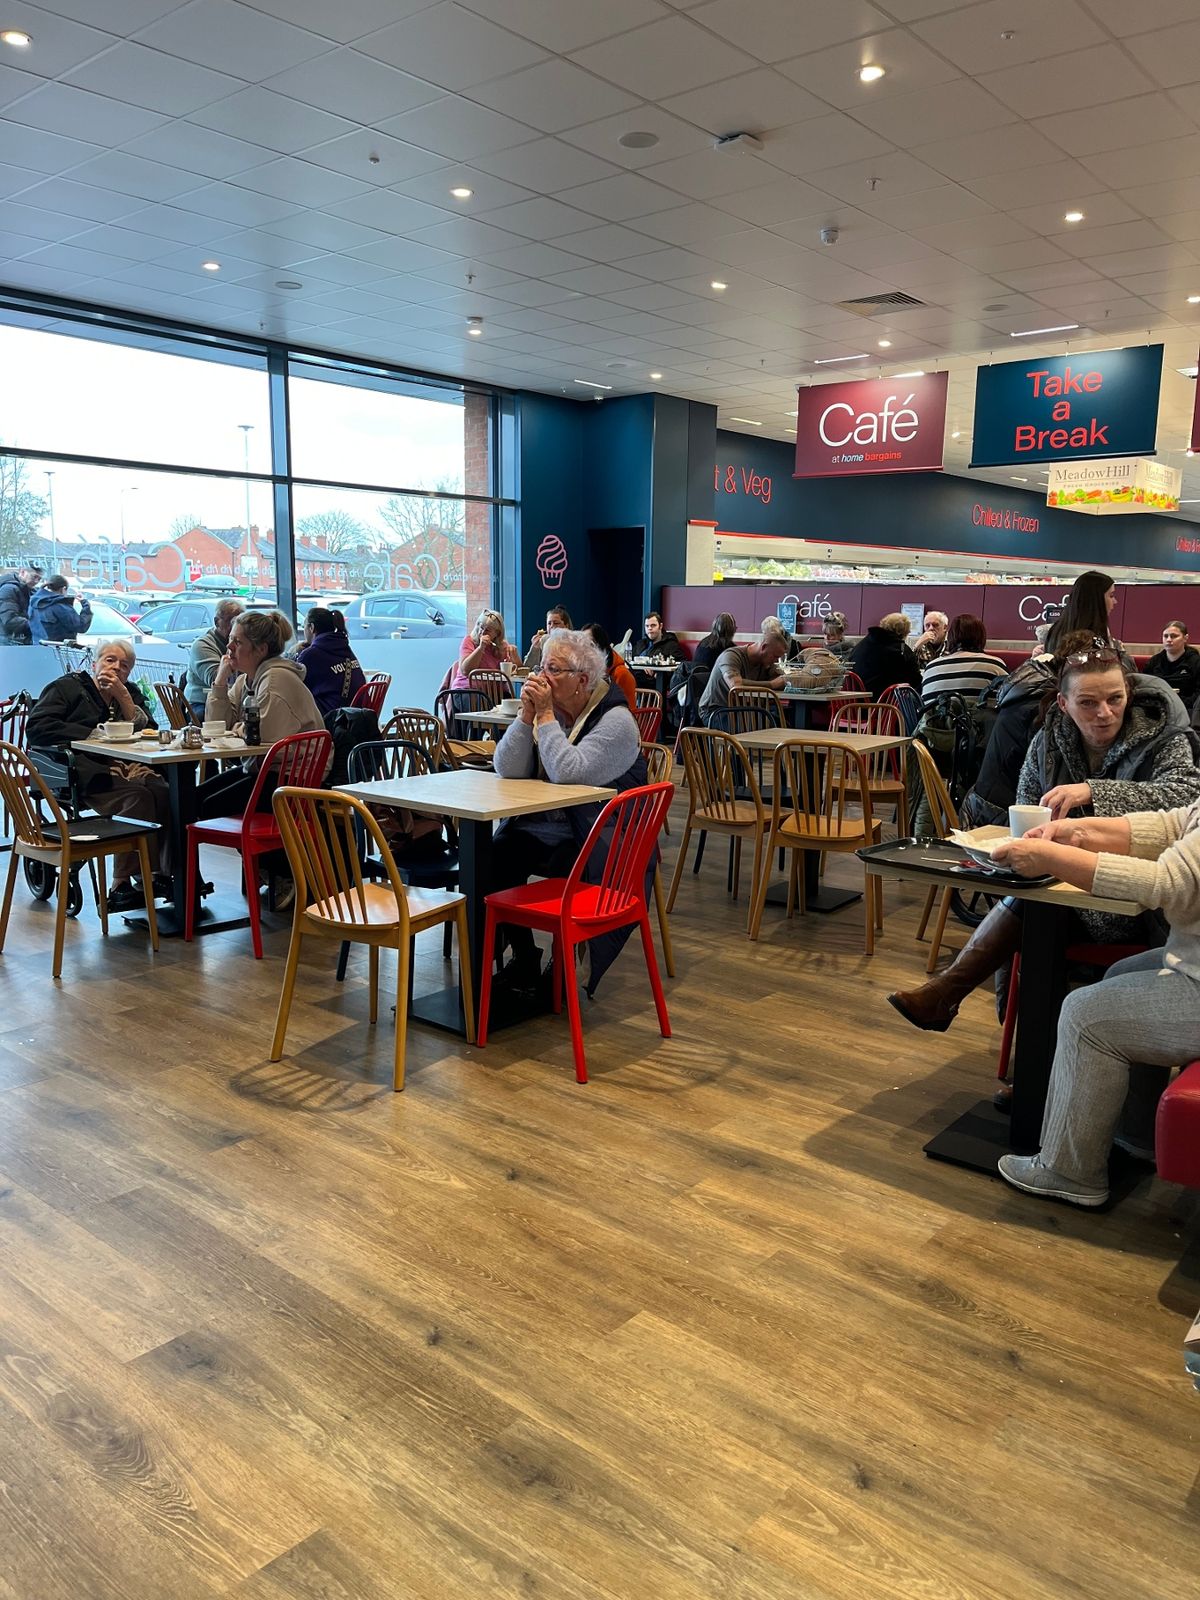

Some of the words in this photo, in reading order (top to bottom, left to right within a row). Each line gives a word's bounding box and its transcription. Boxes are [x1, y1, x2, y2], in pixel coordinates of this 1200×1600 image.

[1026, 367, 1103, 398] Take
[819, 394, 919, 447] Café
[1052, 401, 1071, 421] a
[1015, 418, 1109, 451] Break
[831, 455, 840, 463] at
[841, 453, 864, 463] home
[864, 451, 902, 461] bargains
[725, 465, 737, 493] &
[741, 466, 772, 504] Veg
[1055, 465, 1130, 480] MeadowHill
[972, 504, 1003, 528] Chilled
[1004, 509, 1011, 529] &
[1012, 511, 1040, 533] Frozen
